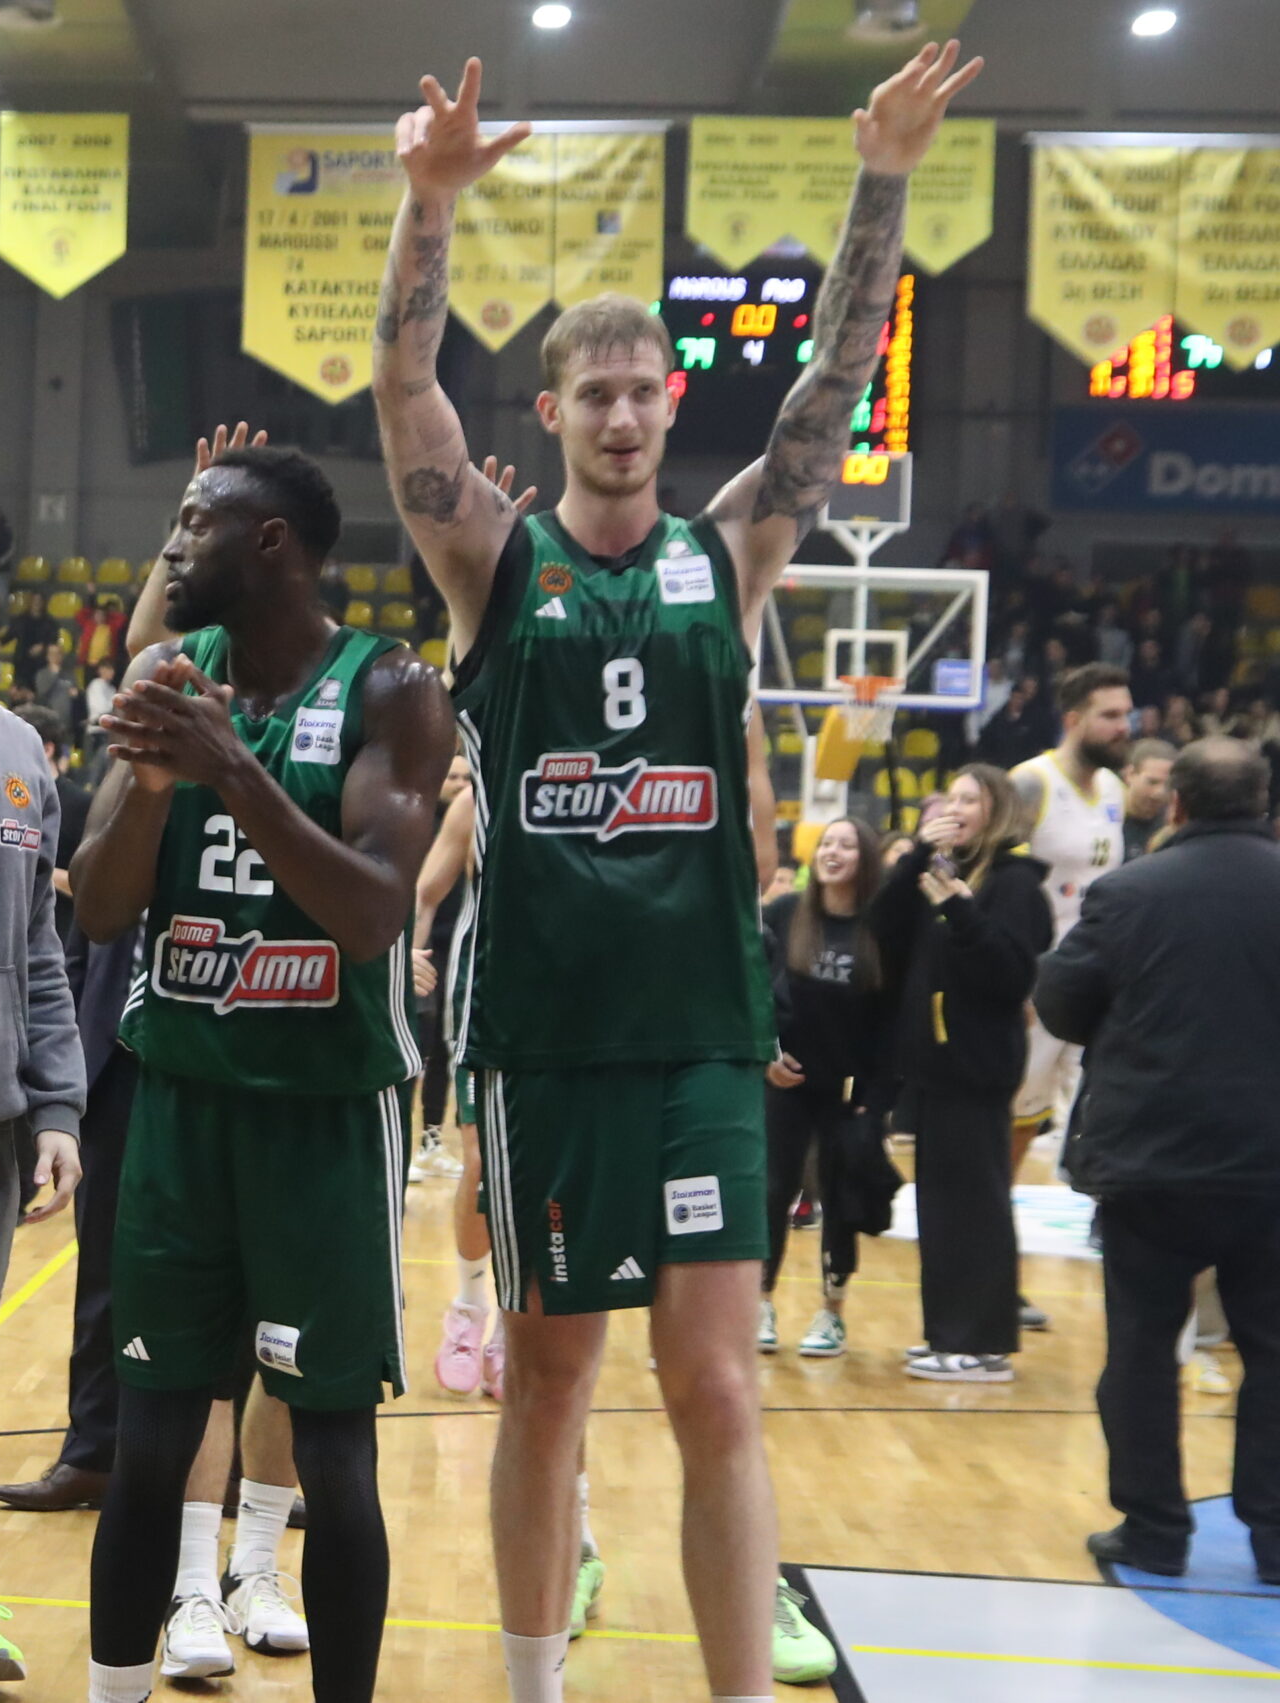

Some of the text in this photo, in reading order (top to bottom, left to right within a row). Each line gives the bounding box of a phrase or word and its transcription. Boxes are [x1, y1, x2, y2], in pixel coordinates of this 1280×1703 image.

[323, 150, 400, 168] SAPORT
[288, 302, 376, 320] ΚΥΠΕΛΛΟ
[295, 324, 371, 342] SAPORT
[603, 657, 647, 730] 8
[546, 759, 588, 777] pame
[199, 814, 274, 896] 22
[174, 922, 215, 943] pame
[549, 1200, 569, 1283] instacar
